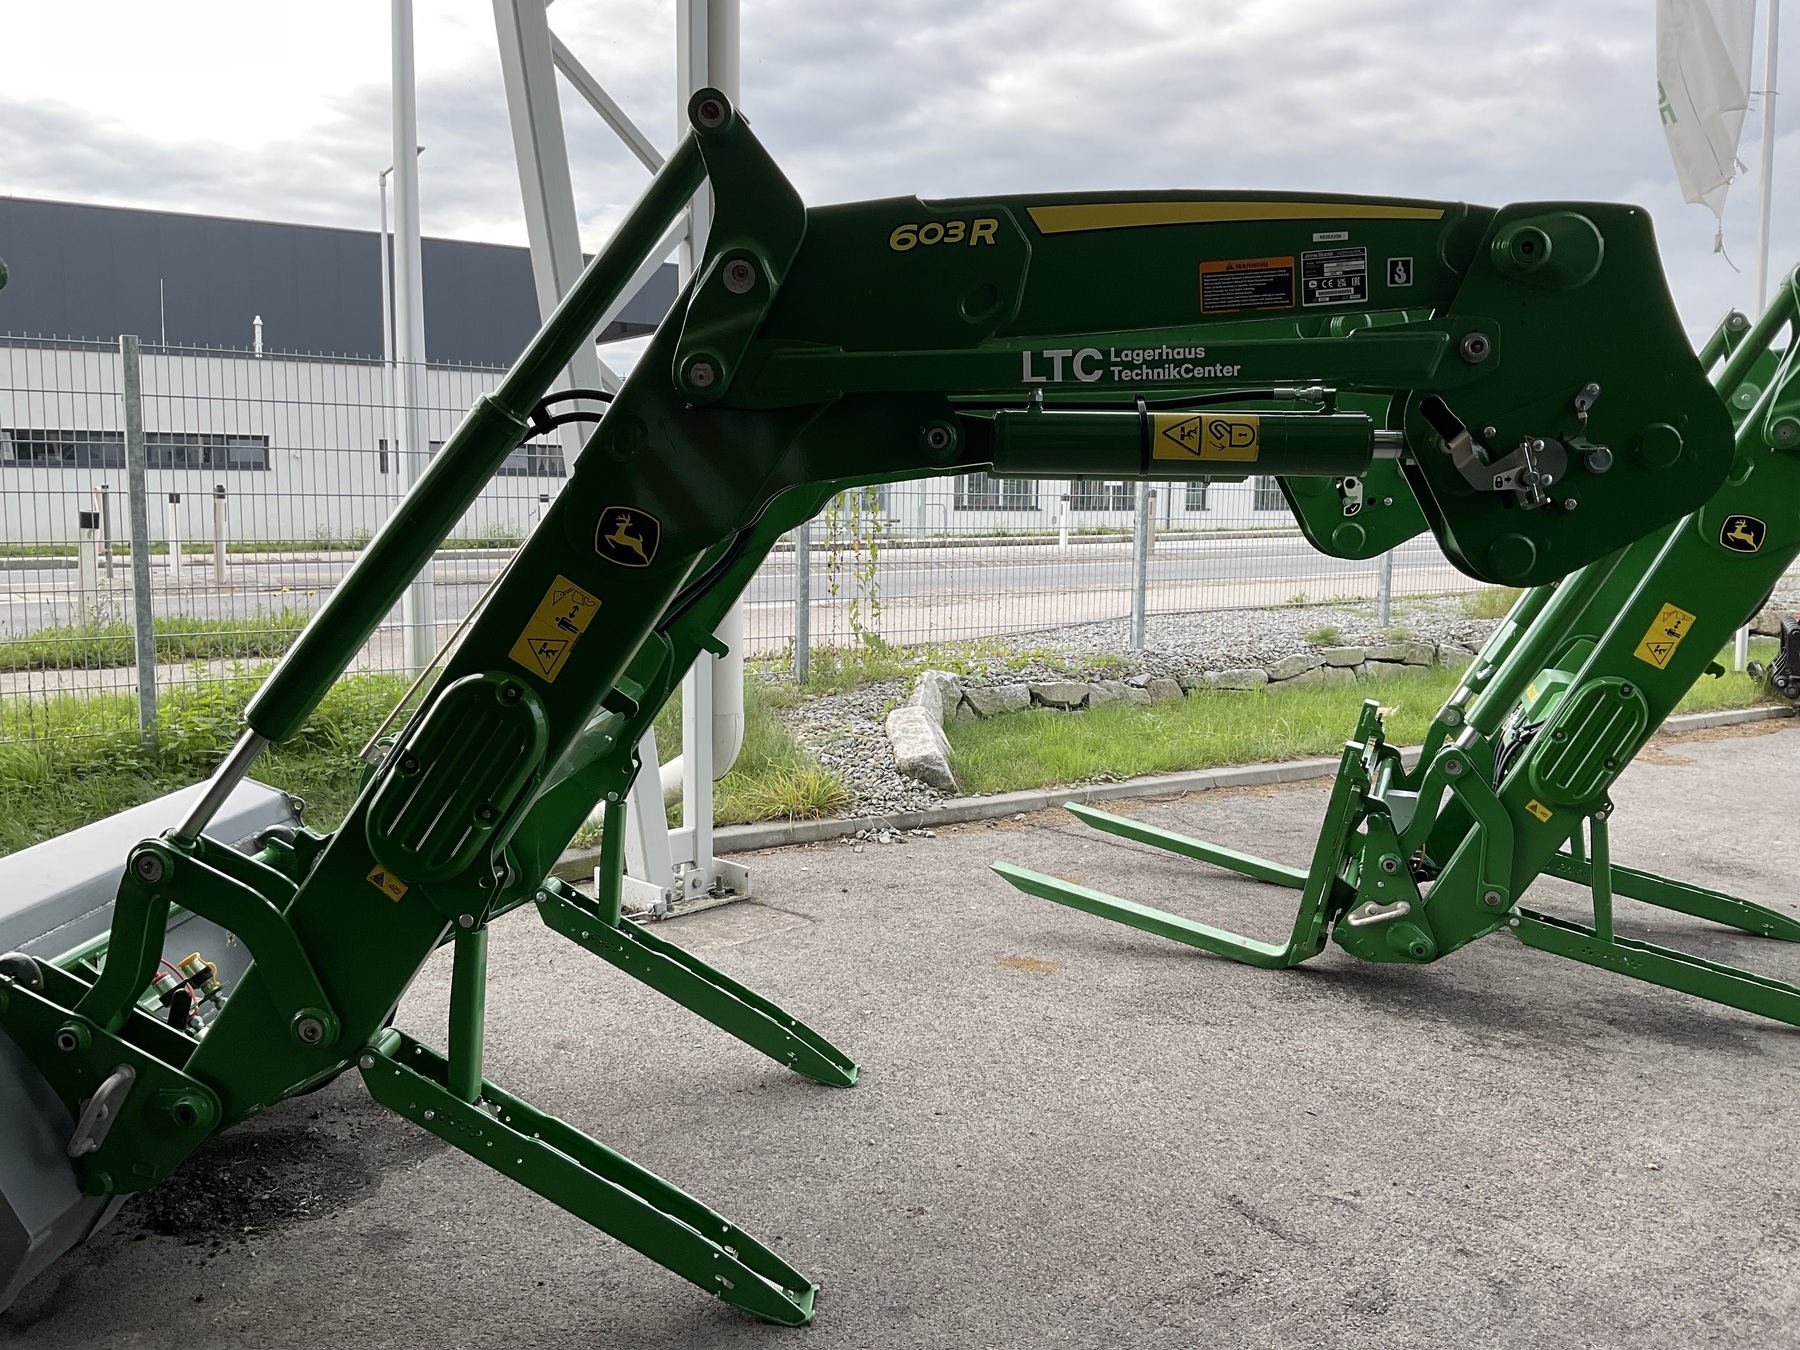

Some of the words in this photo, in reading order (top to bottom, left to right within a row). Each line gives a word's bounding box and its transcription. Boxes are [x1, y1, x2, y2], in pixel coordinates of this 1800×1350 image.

[888, 218, 1000, 252] 603R
[1235, 261, 1269, 270] WARNING
[1110, 345, 1206, 363] Lagerhaus
[1022, 348, 1104, 383] LTC
[1110, 363, 1241, 382] TechnikCenter
